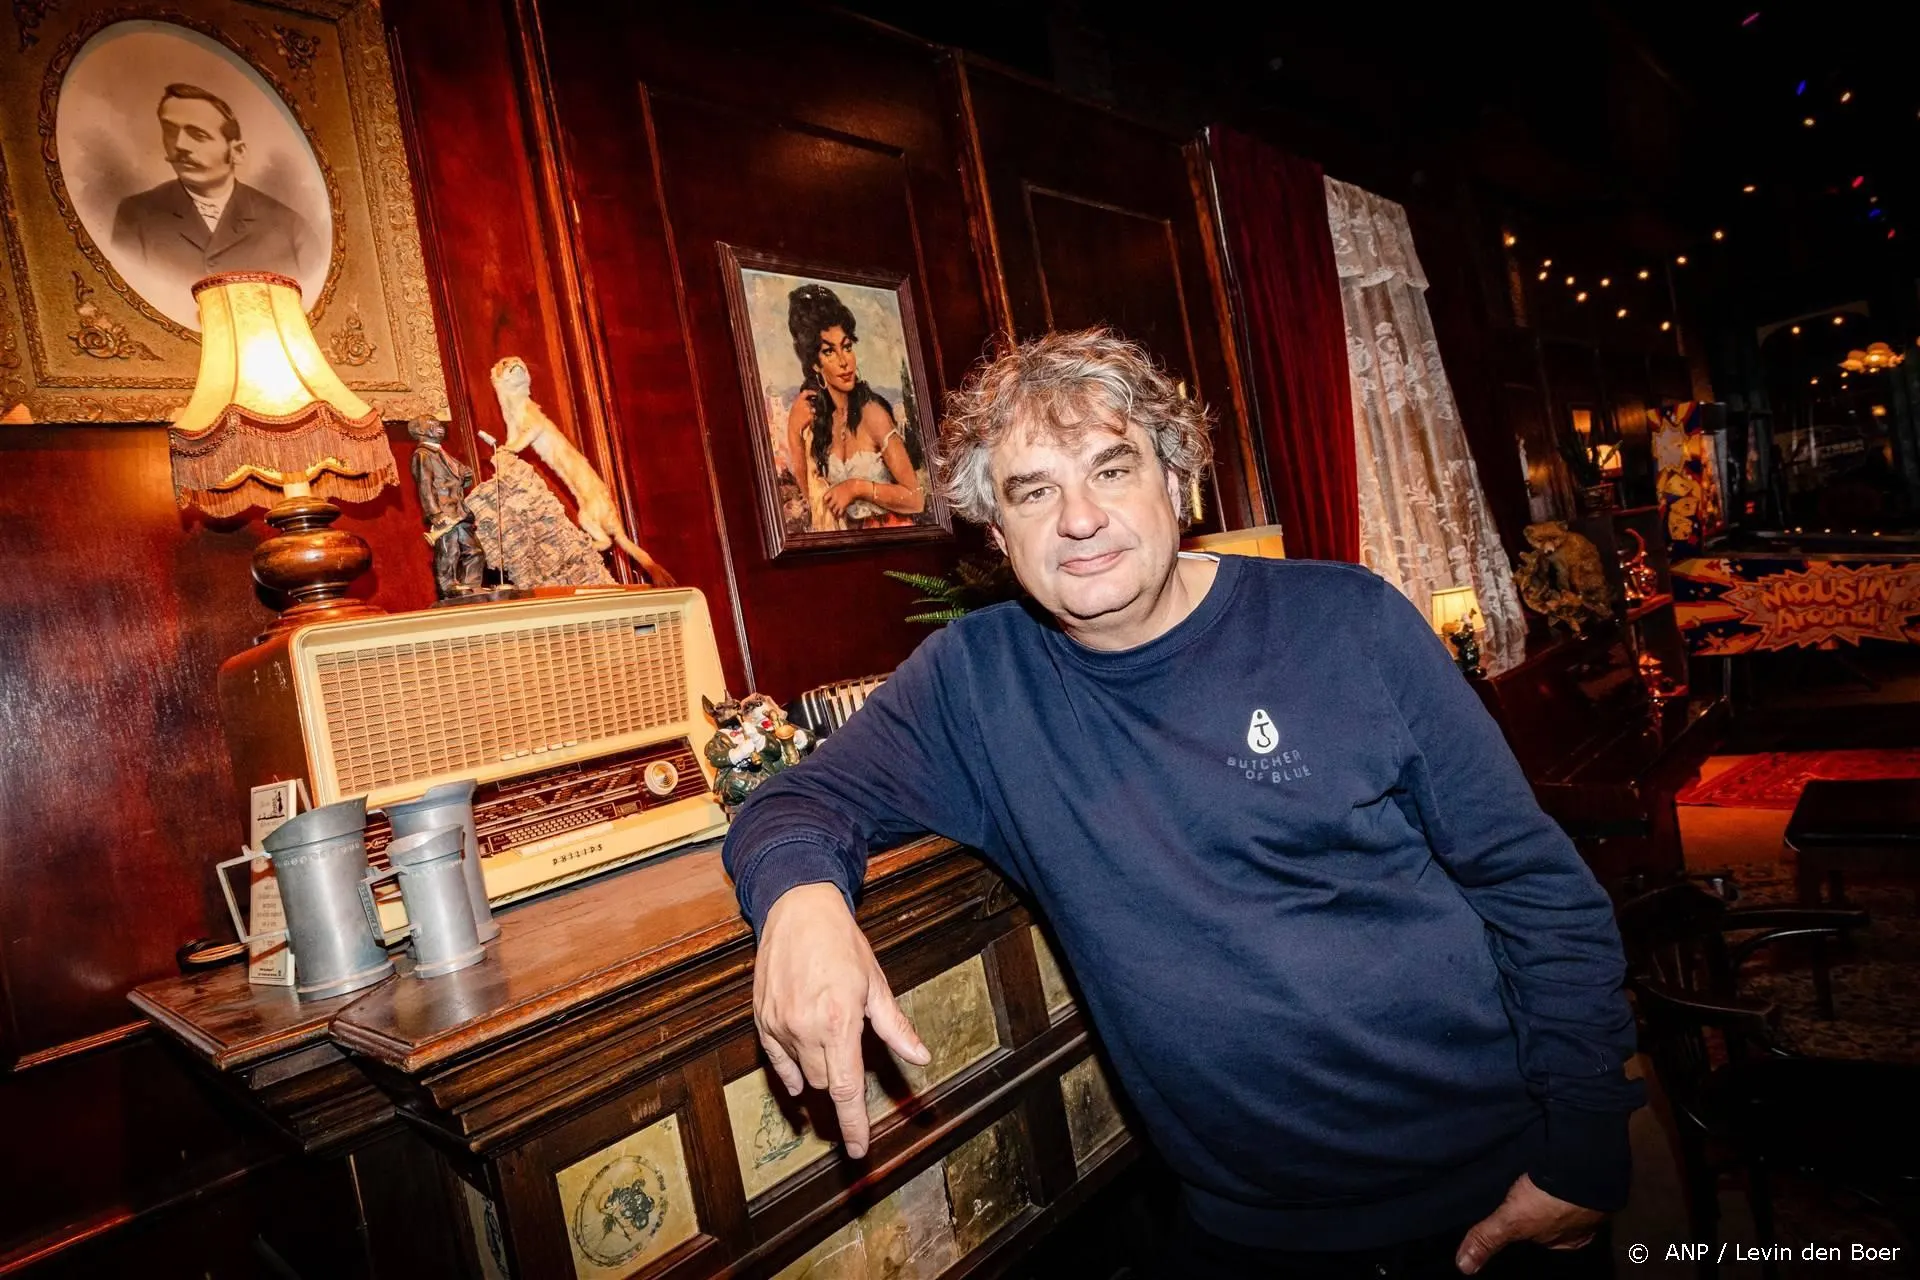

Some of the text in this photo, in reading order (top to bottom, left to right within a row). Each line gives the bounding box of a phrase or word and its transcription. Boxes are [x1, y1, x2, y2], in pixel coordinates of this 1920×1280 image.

[1227, 749, 1301, 769] BUTCHER
[1245, 764, 1312, 784] OF BLUE
[552, 843, 603, 866] PHILIPS
